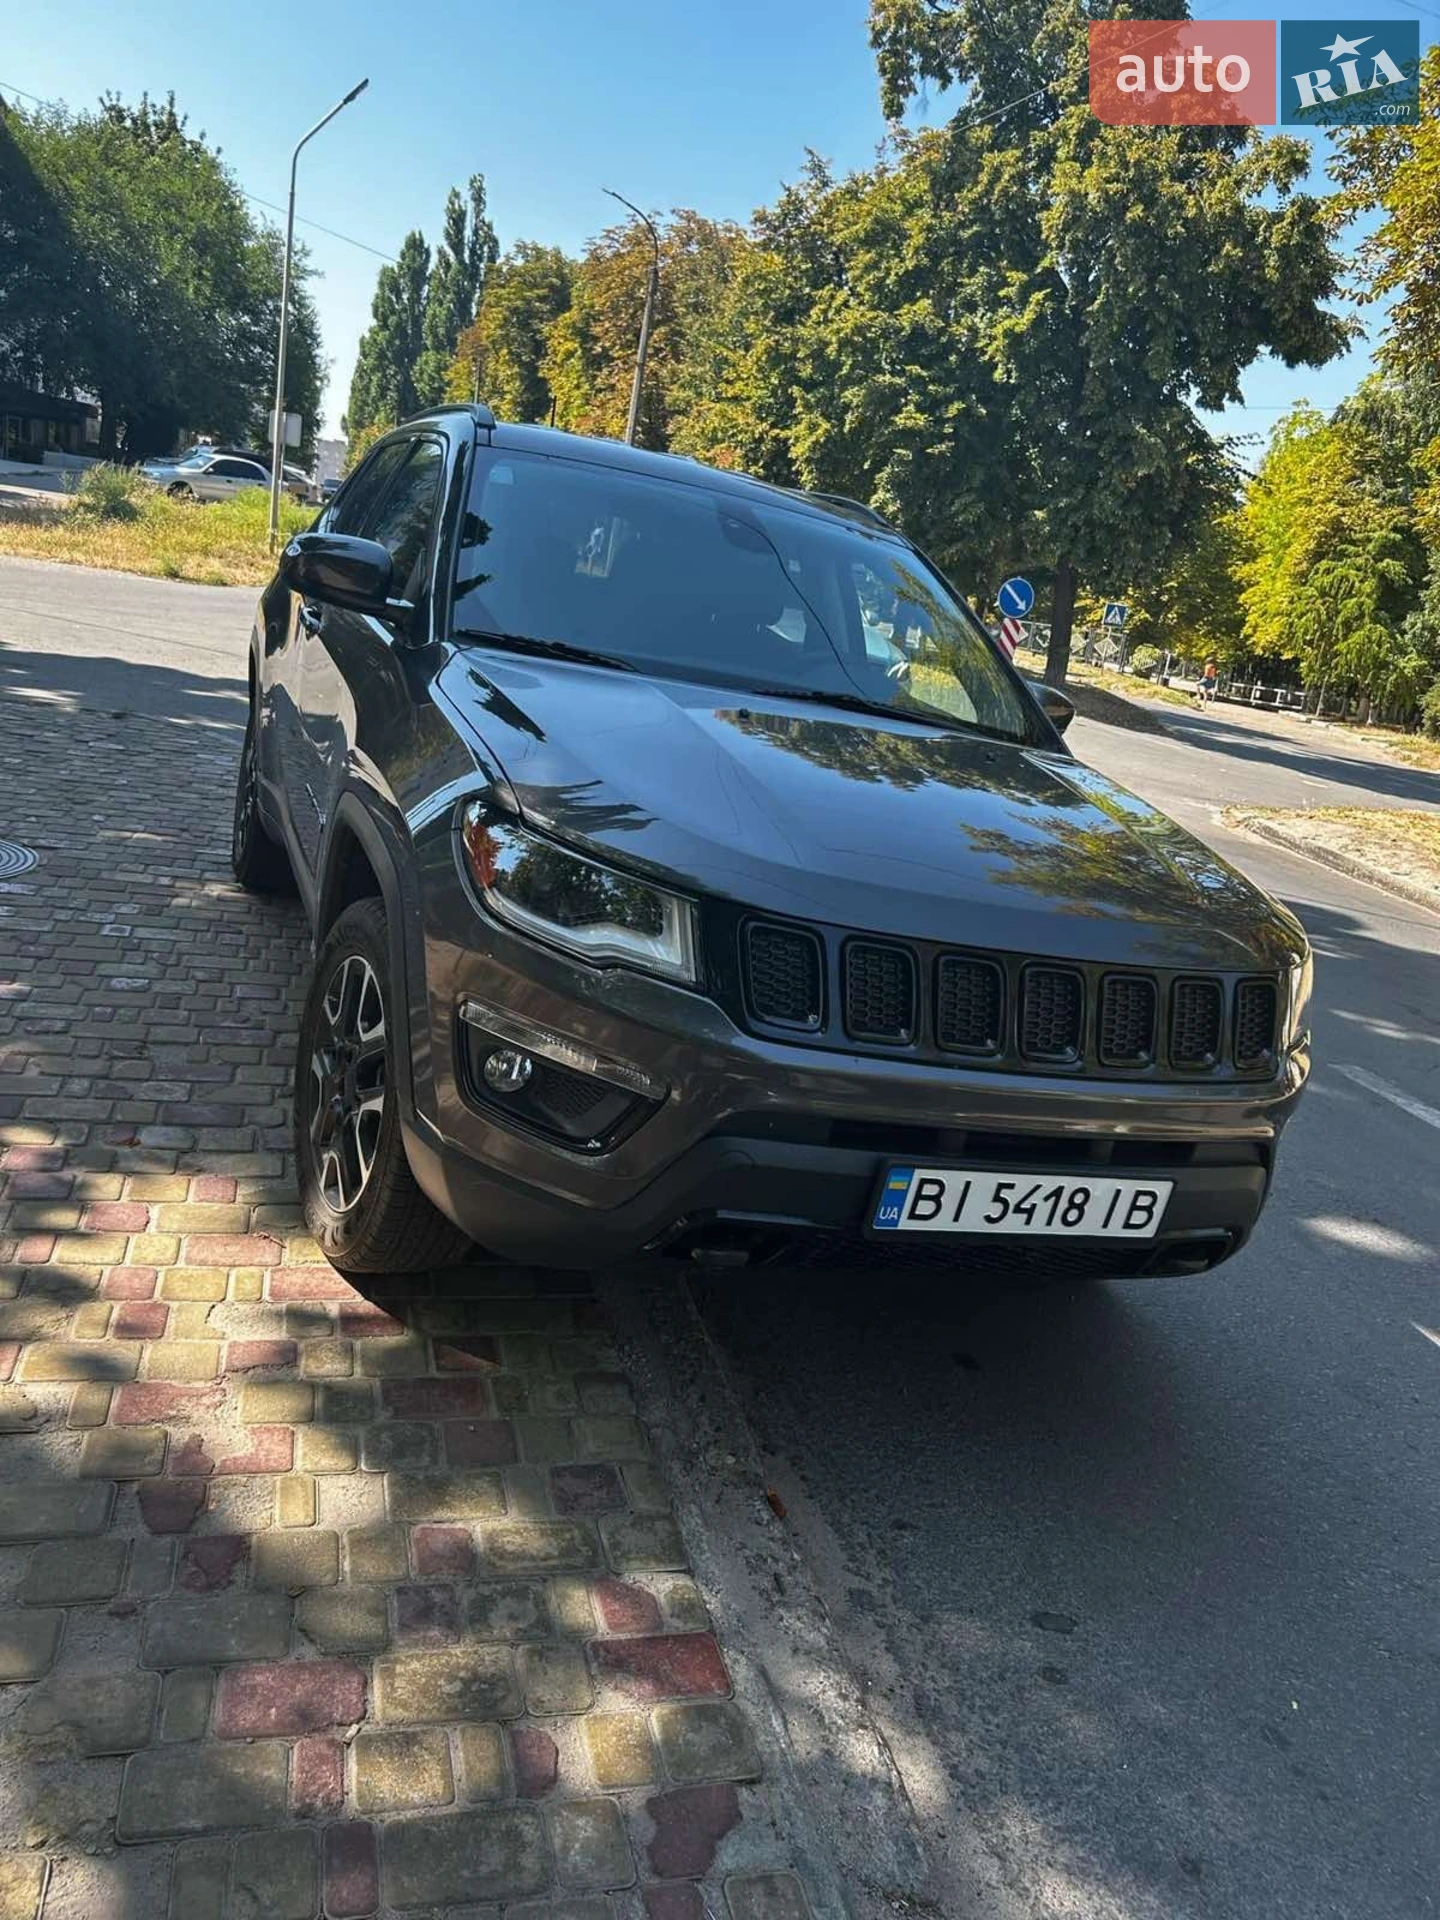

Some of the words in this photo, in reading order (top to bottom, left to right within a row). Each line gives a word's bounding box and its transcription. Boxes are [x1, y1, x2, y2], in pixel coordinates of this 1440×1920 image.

[879, 1206, 899, 1220] UA
[907, 1177, 972, 1223] BI
[983, 1182, 1091, 1227] 5418
[1101, 1188, 1159, 1230] IB
